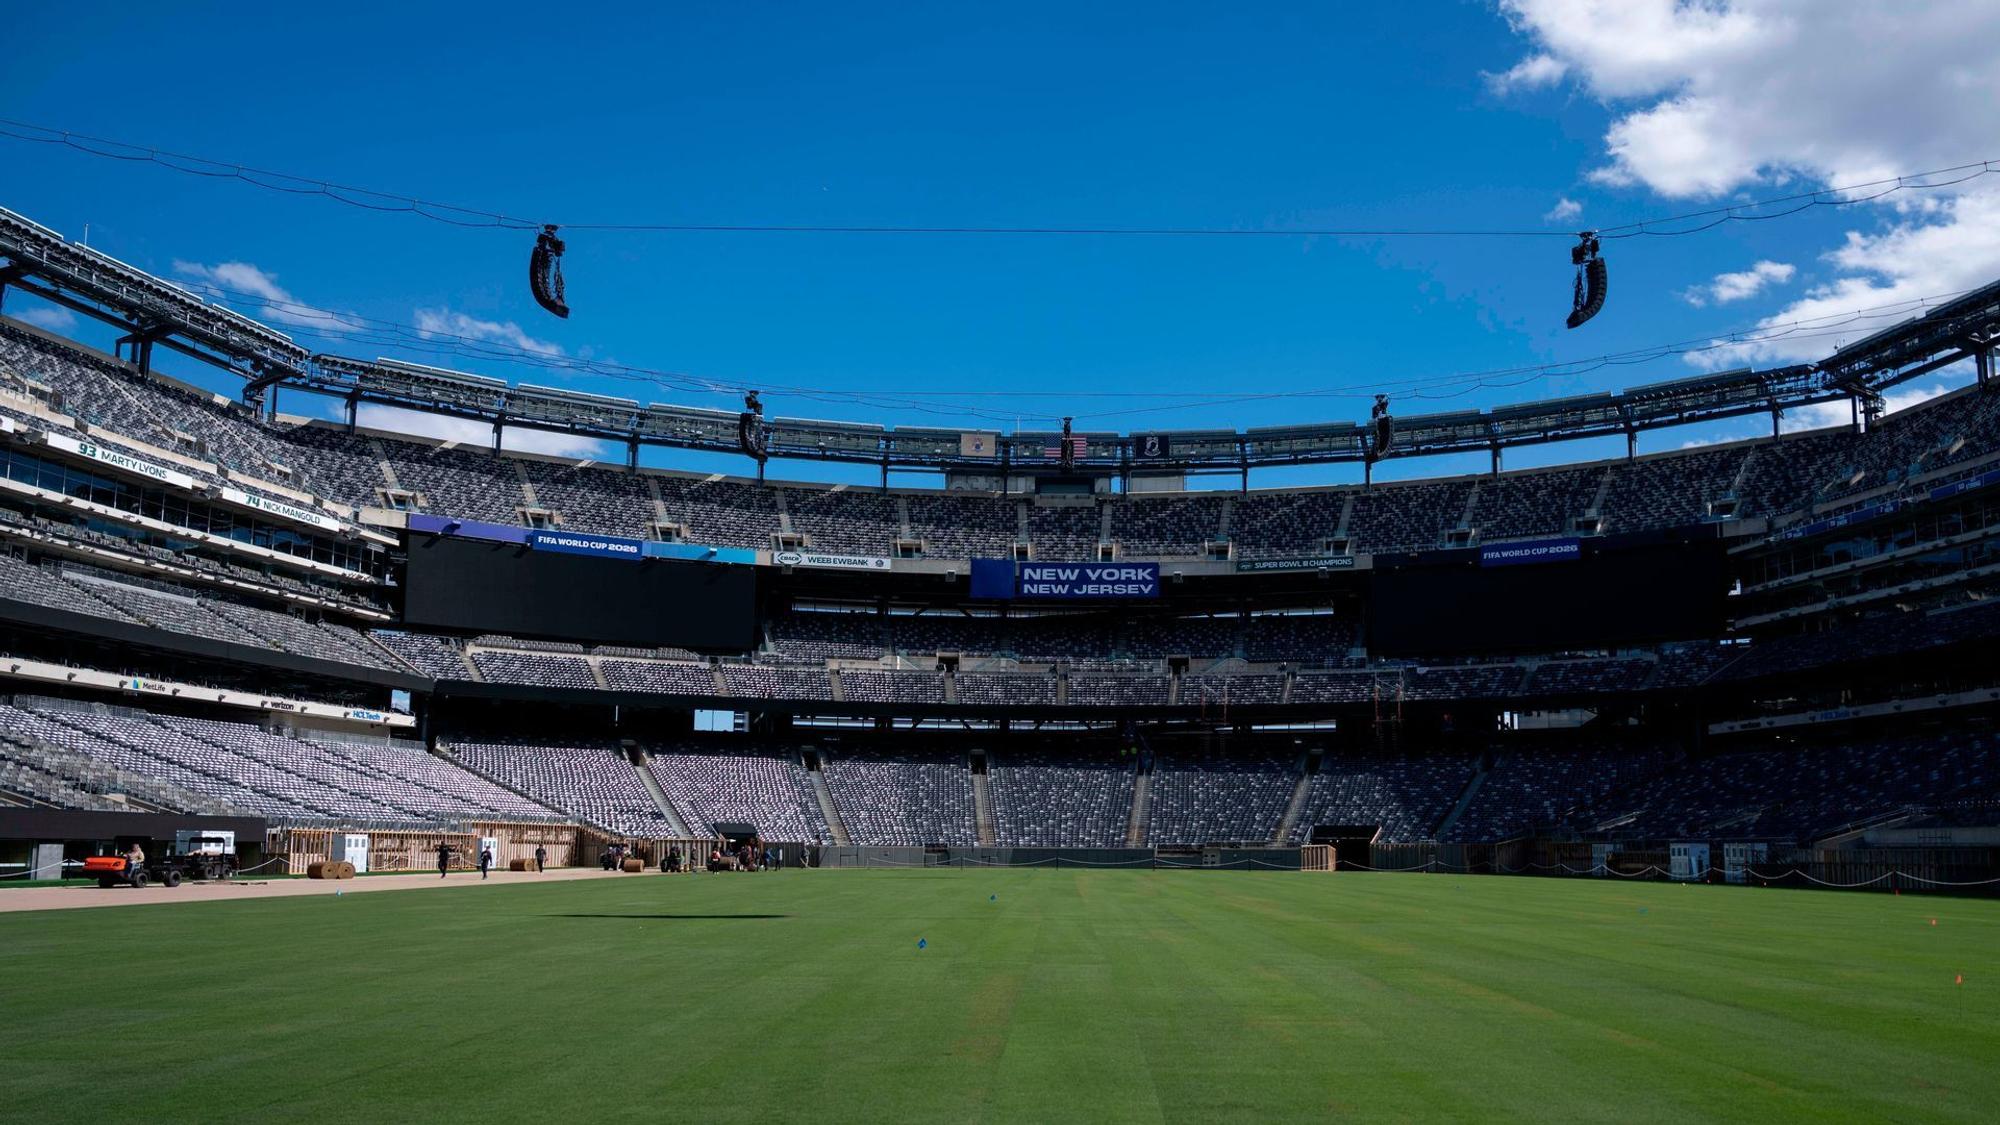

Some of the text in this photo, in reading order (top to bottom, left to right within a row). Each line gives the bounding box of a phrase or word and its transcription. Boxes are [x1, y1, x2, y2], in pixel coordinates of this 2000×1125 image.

[78, 443, 168, 479] 93 MARTY LYONS
[245, 494, 321, 525] 74 NICK MANGOLD
[538, 535, 638, 553] FIFA WORLD CUP 2026
[1483, 544, 1579, 560] FIFA WORLD CUP 2026
[808, 556, 833, 564] WEEB
[833, 557, 869, 566] EWBANK
[1255, 560, 1278, 569] SUPER
[1279, 560, 1301, 568] BOWL
[1309, 558, 1353, 567] CHAMPIONS
[1023, 568, 1154, 581] NEW YORK
[1023, 584, 1154, 594] NEW JERSEY
[142, 682, 166, 692] MetLife
[270, 701, 295, 711] verizon
[353, 710, 381, 721] HCLTech
